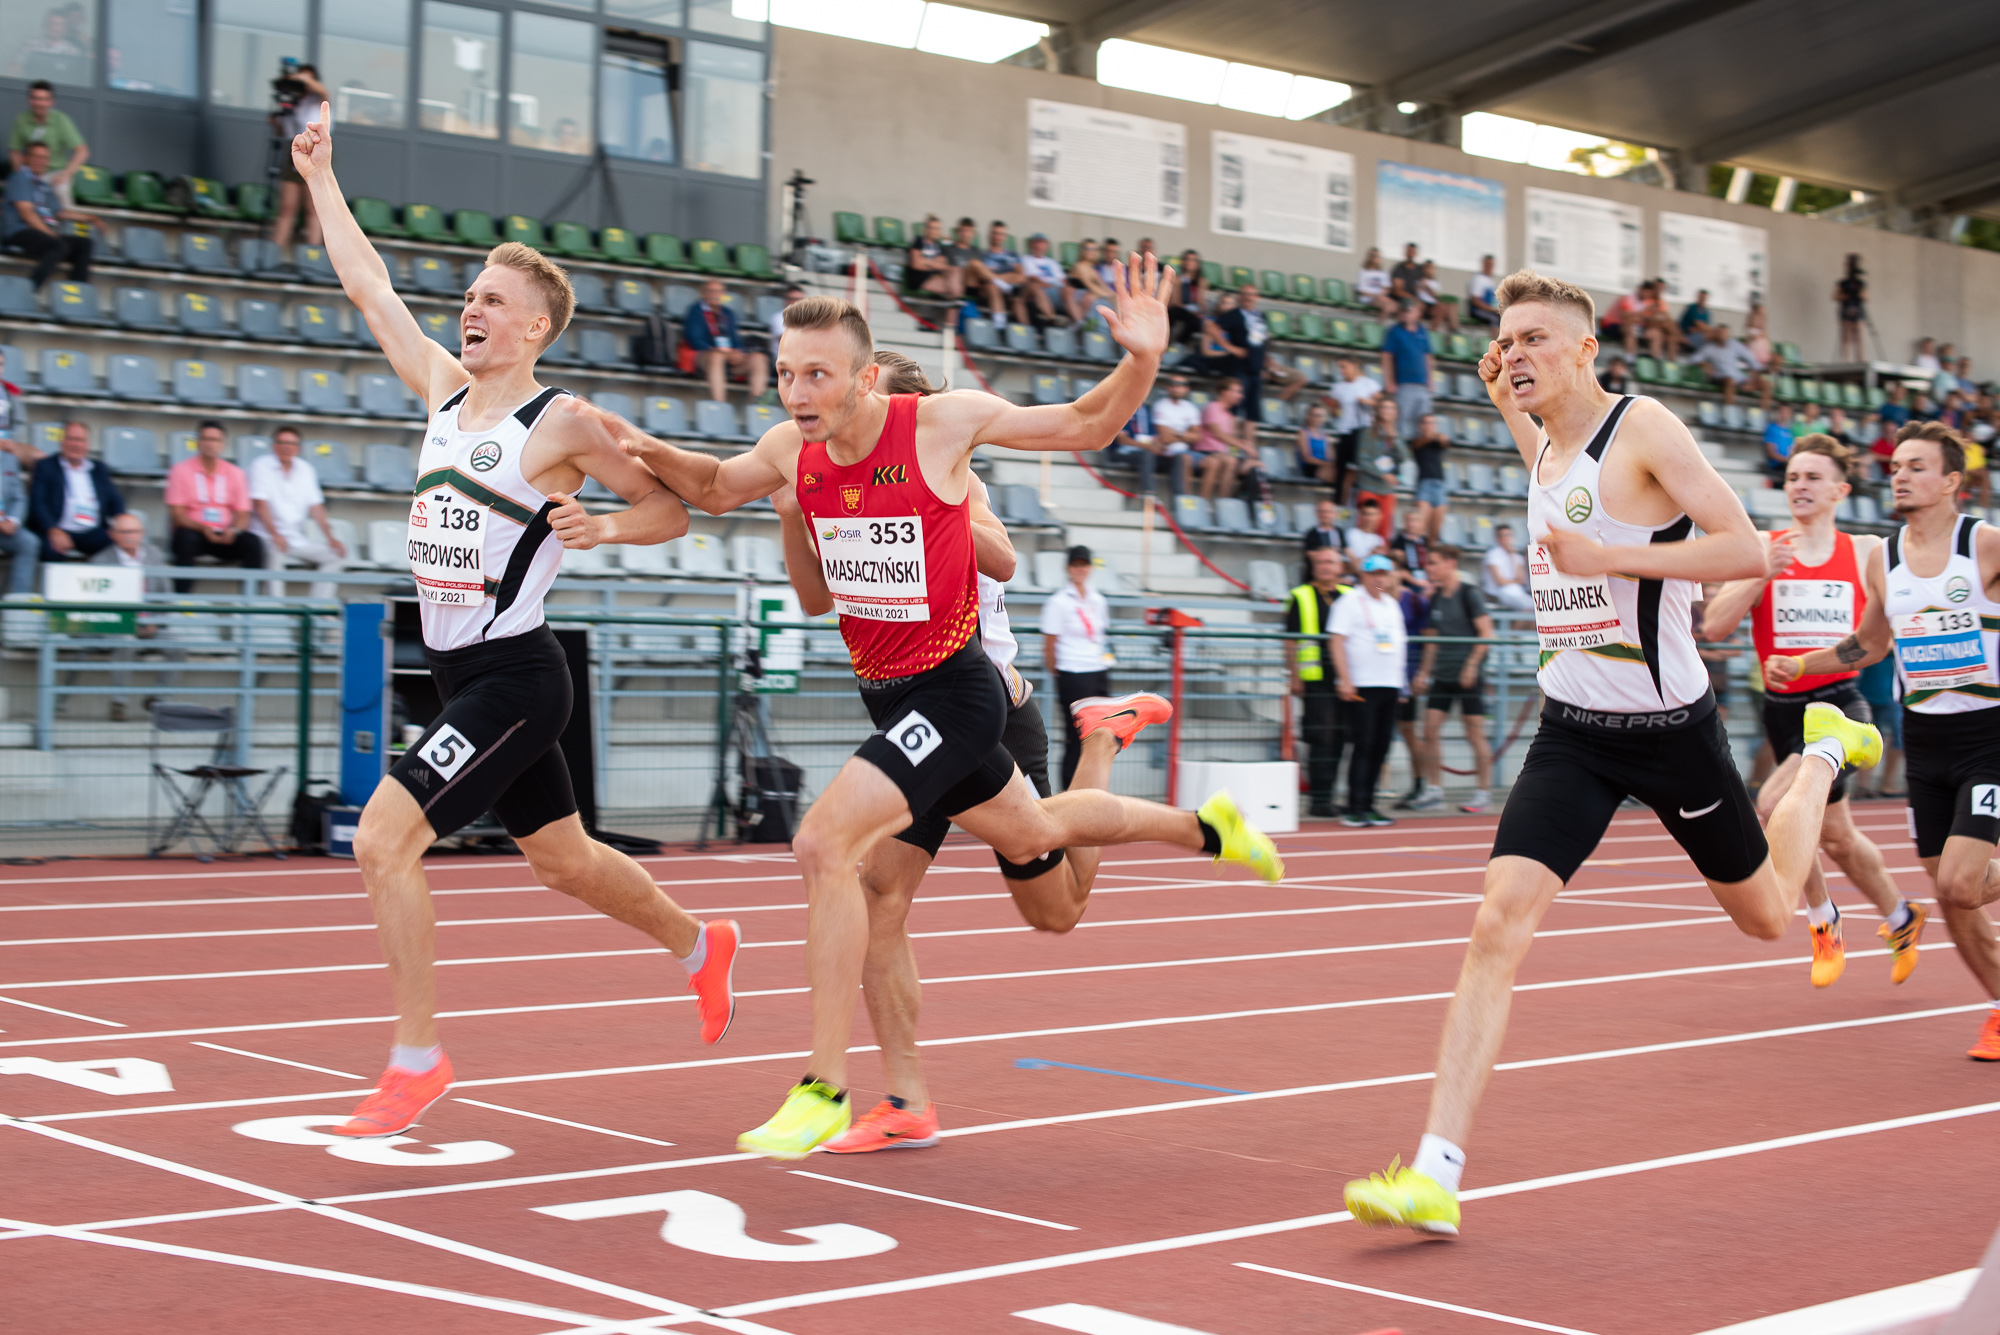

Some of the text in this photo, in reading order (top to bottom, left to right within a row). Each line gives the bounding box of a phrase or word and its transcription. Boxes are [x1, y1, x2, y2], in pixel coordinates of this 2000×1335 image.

[440, 507, 481, 531] 138
[839, 529, 862, 539] OSIR
[868, 521, 916, 545] 353
[408, 539, 480, 570] OSTROWSKI
[826, 556, 920, 584] MASACZYŃSKI
[440, 591, 466, 603] 2021
[1823, 583, 1844, 598] 27
[846, 604, 909, 619] SUWAŁKI 2021
[1777, 607, 1852, 624] DOMINIAK
[1938, 612, 1974, 632] 133
[1579, 633, 1605, 646] 2021
[1562, 706, 1689, 729] NIKE PRO
[900, 723, 931, 751] 6
[430, 734, 466, 767] 5
[1980, 787, 1998, 813] 4
[231, 1114, 516, 1167] 3
[528, 1188, 898, 1263] 2
